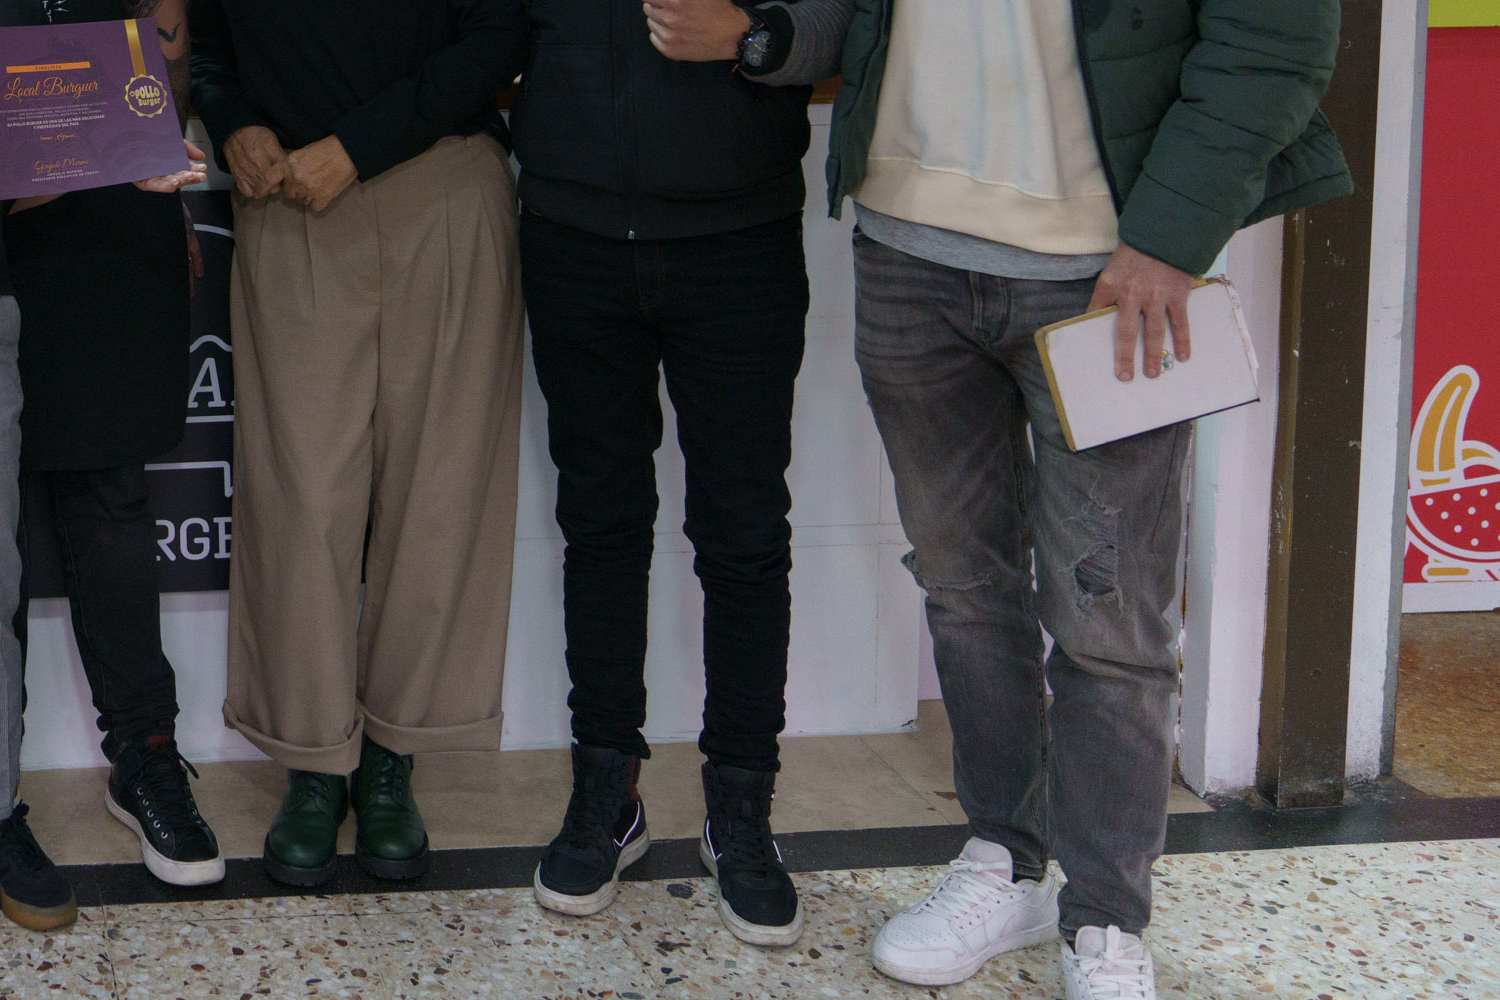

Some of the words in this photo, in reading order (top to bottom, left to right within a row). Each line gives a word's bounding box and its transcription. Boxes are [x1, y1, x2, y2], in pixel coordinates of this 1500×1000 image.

[4, 77, 41, 103] Local
[43, 76, 99, 99] Burguer
[135, 86, 160, 99] POLLO
[138, 96, 160, 107] Burger
